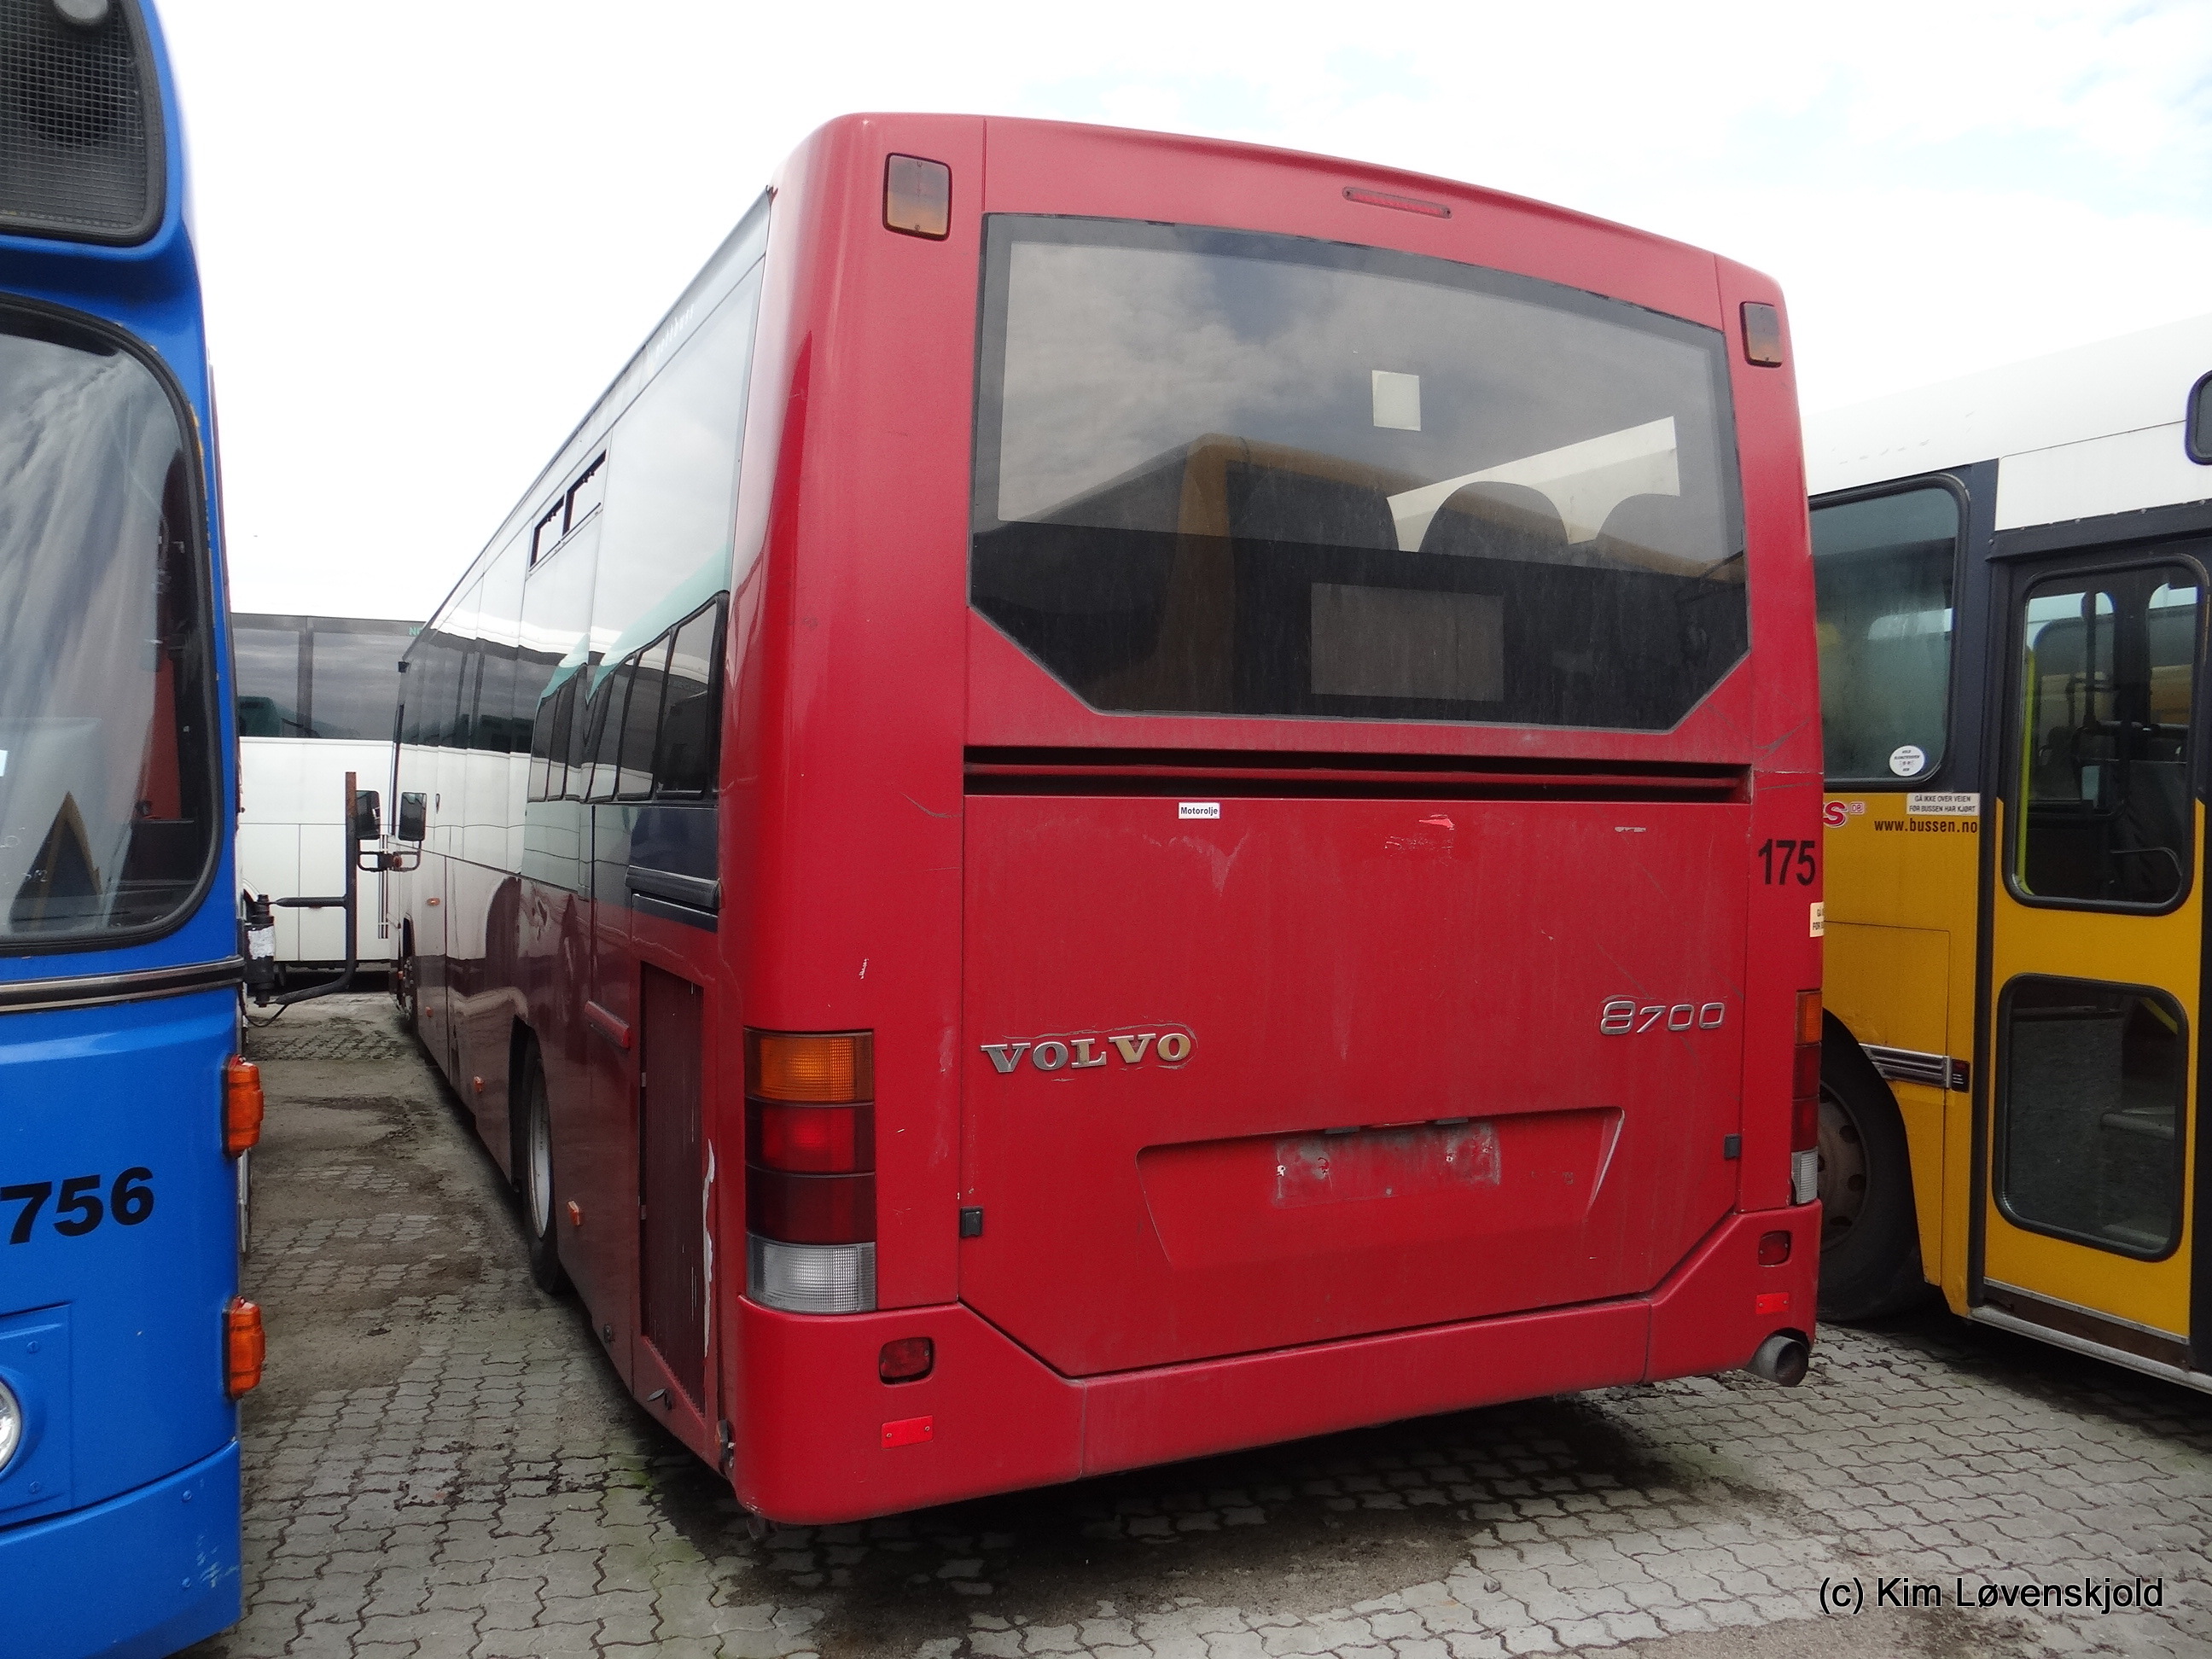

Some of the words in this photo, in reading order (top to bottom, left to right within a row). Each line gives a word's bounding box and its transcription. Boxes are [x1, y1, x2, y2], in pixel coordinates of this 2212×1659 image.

[1180, 806, 1219, 816] Motorolje
[1914, 794, 1923, 802] GÅ
[1874, 818, 1978, 834] www.bussen.no
[1758, 838, 1816, 886] 175
[1600, 1000, 1725, 1035] 8700
[980, 1033, 1191, 1073] VOLVO
[0, 1166, 154, 1245] 756
